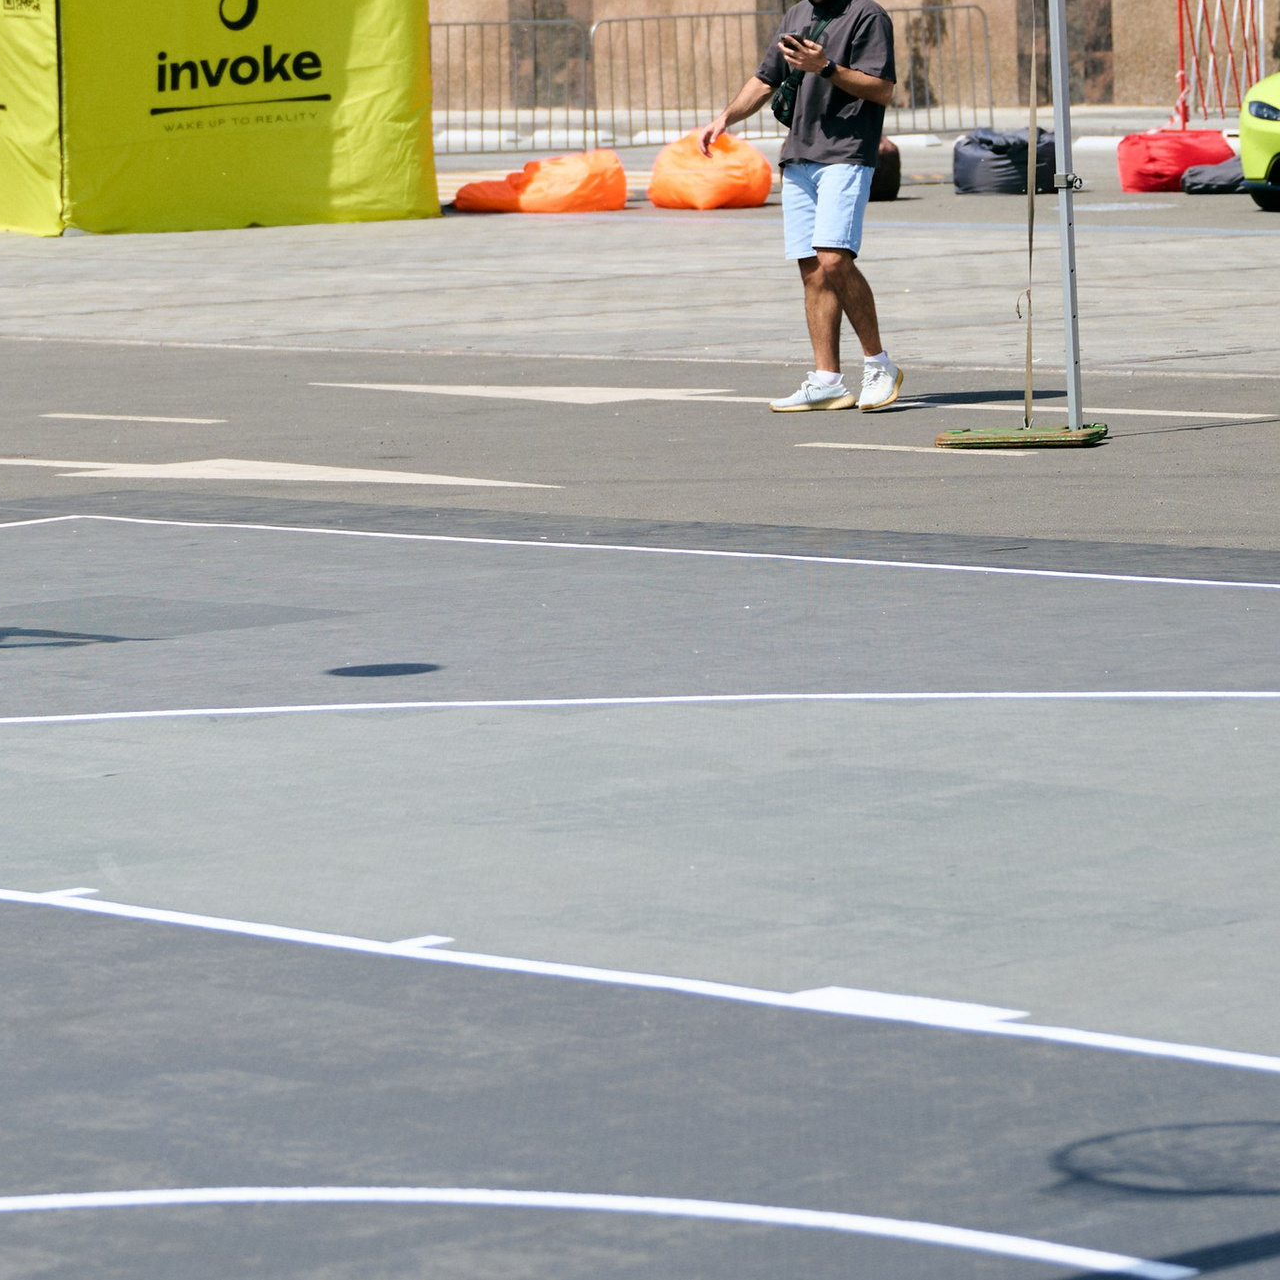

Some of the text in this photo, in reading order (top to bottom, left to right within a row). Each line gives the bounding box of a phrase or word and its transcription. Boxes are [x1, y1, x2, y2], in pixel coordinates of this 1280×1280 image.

[157, 44, 323, 93] invoke
[164, 112, 318, 132] WAKE UP TO REALITY
